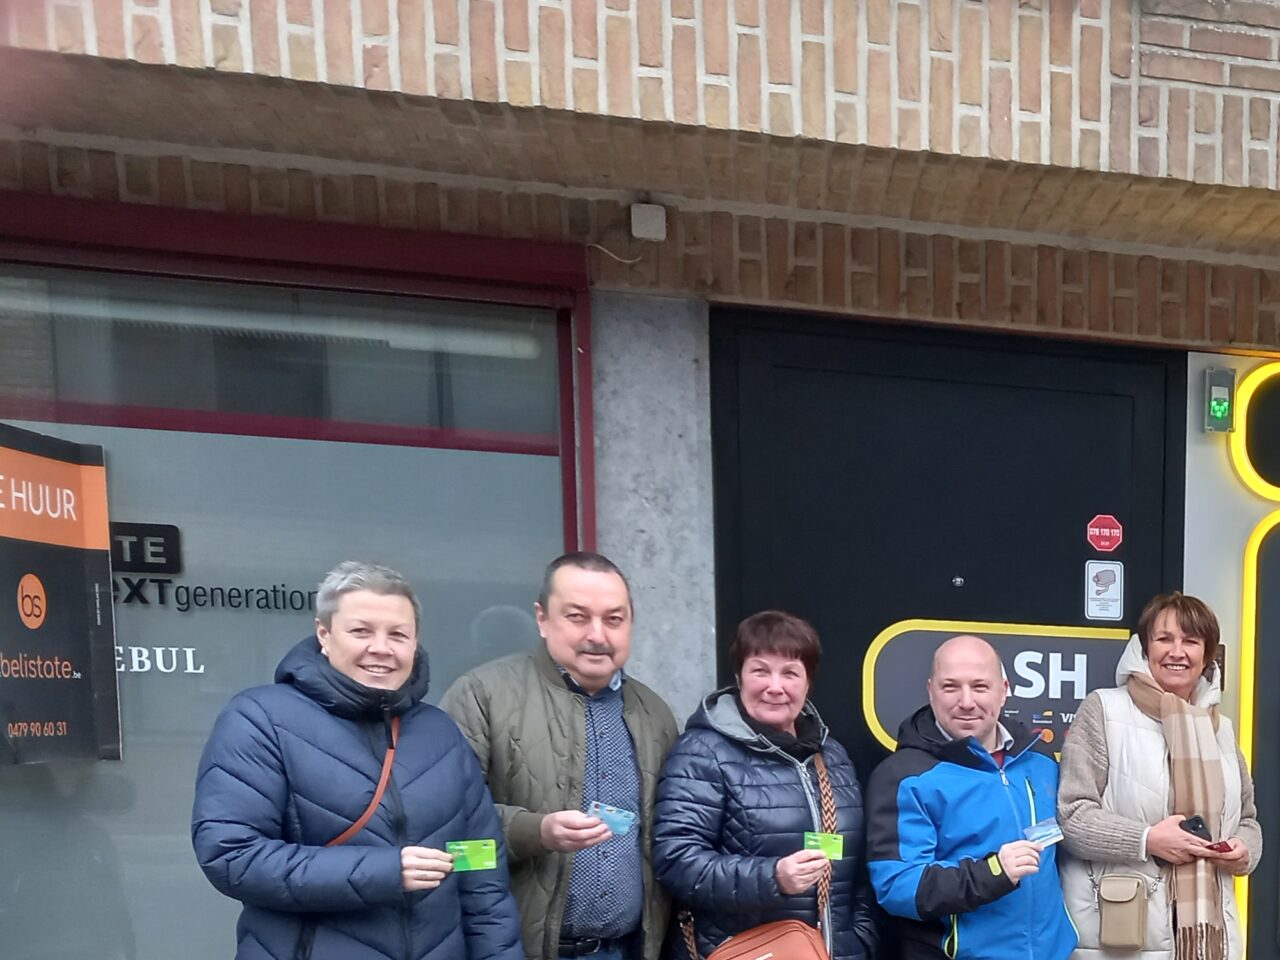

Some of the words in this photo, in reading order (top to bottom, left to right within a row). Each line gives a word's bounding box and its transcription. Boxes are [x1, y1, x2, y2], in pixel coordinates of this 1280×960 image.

[10, 477, 77, 521] HUUR
[20, 583, 43, 619] bs
[1001, 650, 1088, 700] SH
[7, 722, 28, 738] 0479
[29, 722, 41, 737] 90
[43, 721, 55, 737] 60
[56, 721, 67, 736] 31
[1059, 712, 1077, 724] VI
